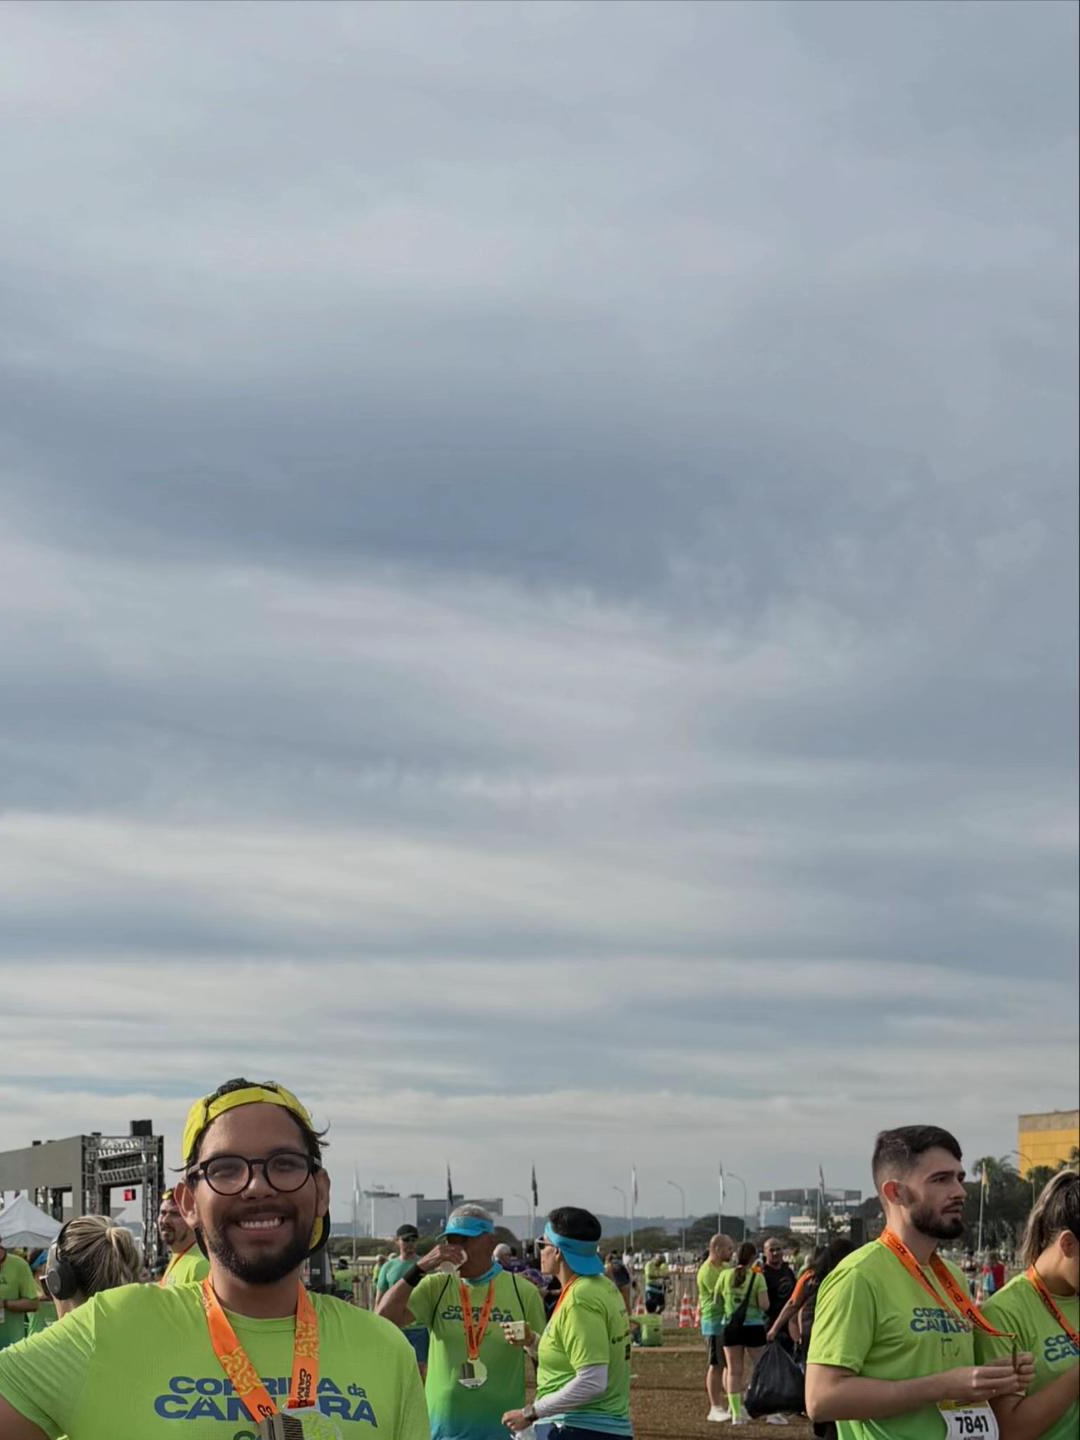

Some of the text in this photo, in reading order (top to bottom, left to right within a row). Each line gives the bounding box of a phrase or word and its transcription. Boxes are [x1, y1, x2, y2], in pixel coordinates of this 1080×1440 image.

[168, 1375, 367, 1399] CORIA da
[955, 1414, 989, 1435] 7841
